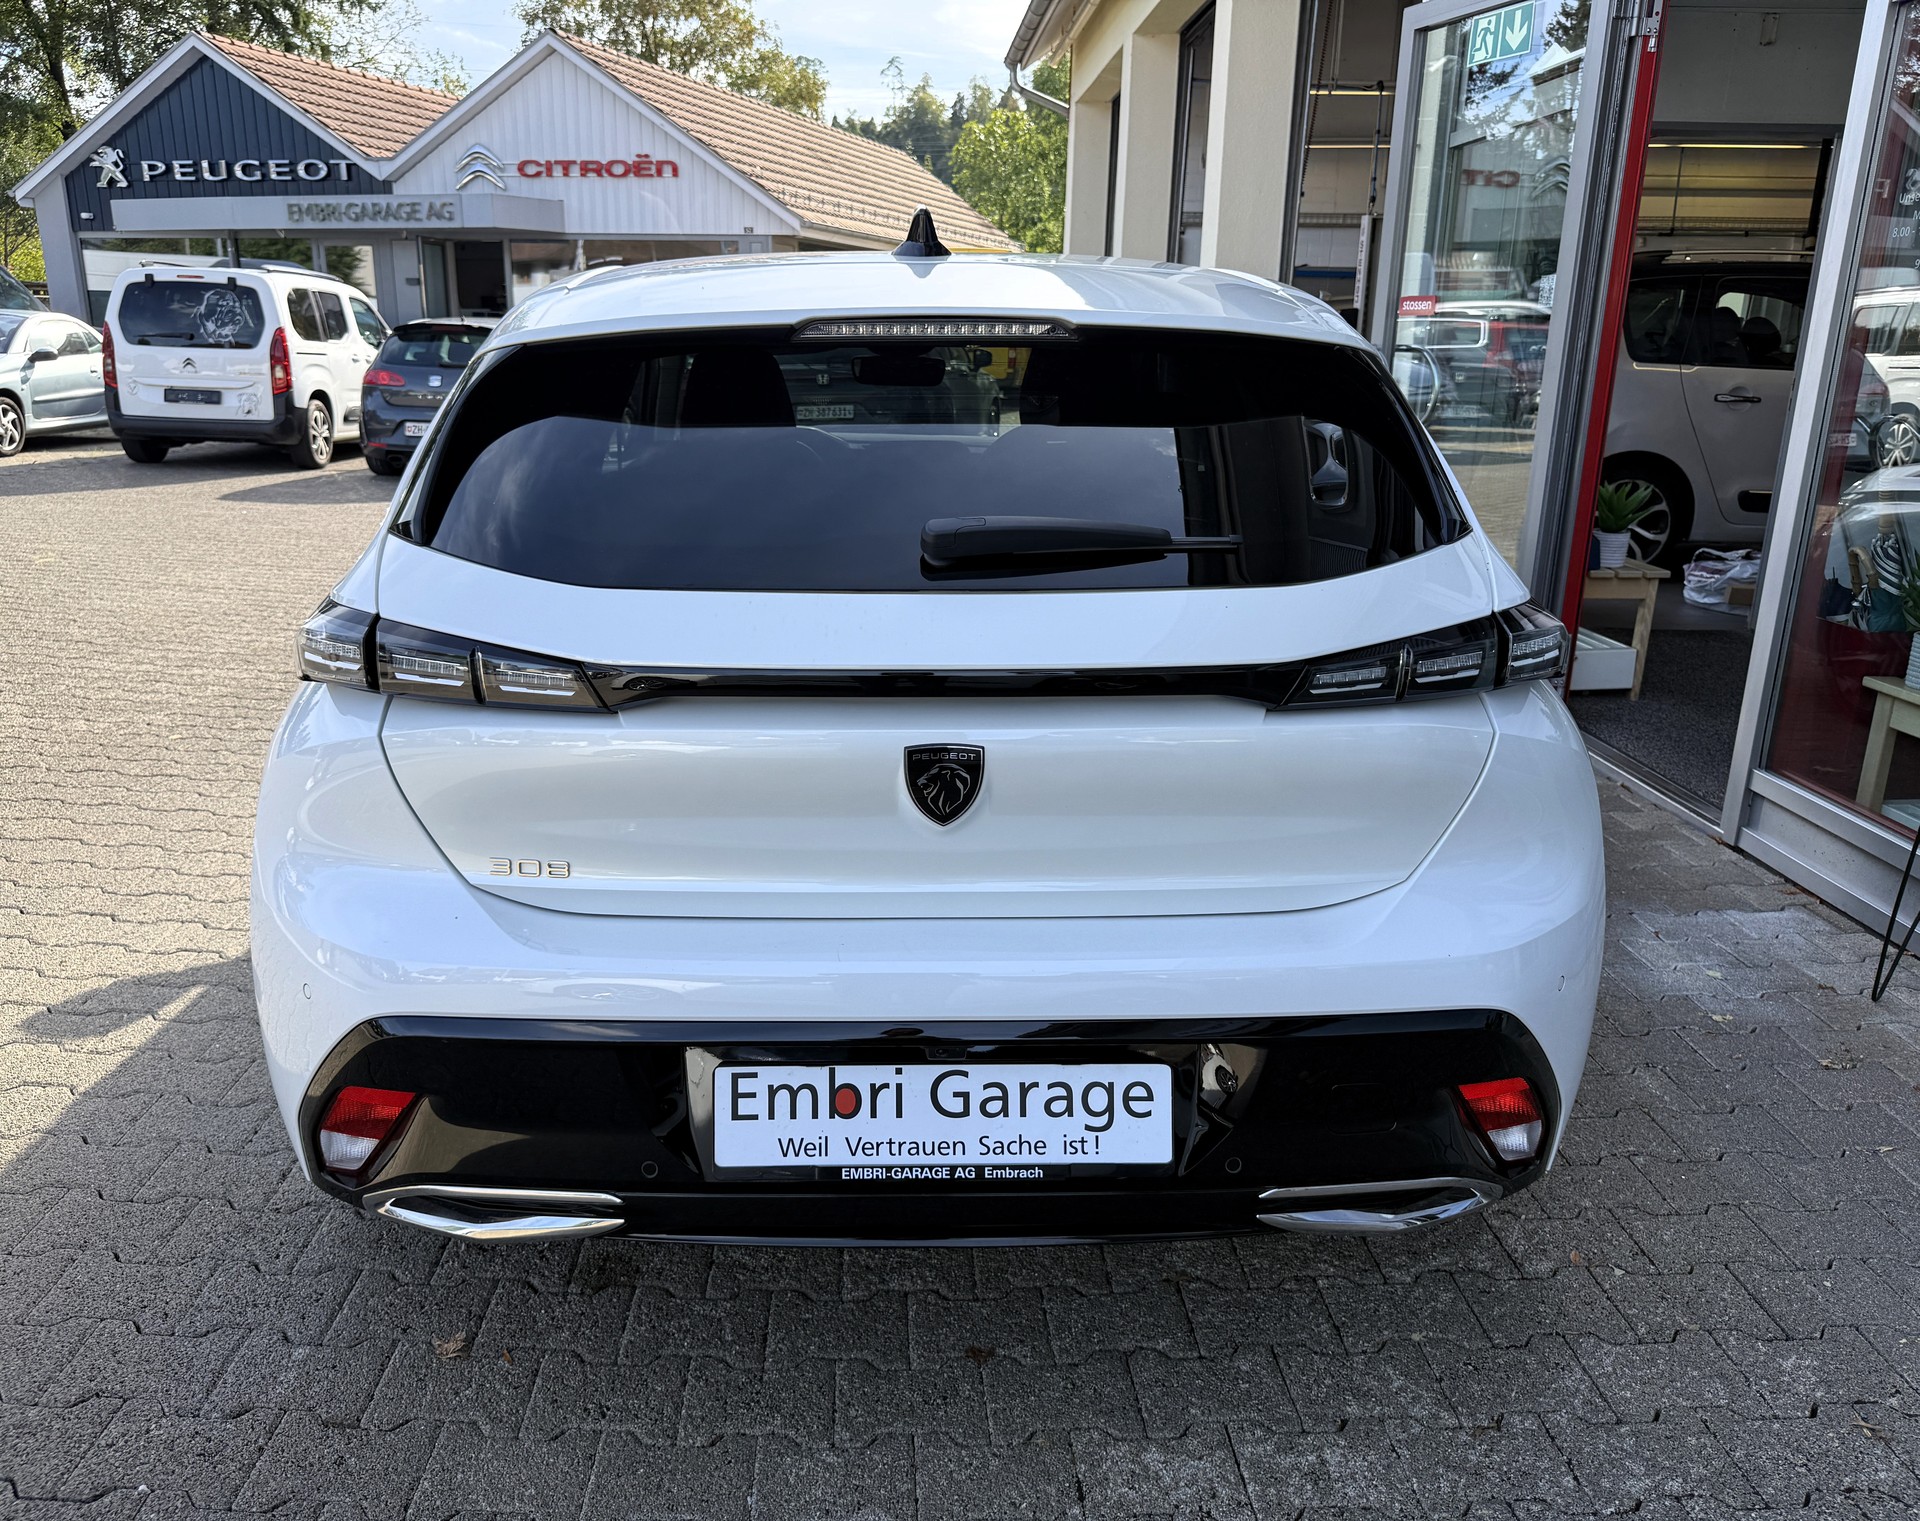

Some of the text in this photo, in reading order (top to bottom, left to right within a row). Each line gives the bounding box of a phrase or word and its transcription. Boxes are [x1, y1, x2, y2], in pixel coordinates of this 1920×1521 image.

[140, 159, 355, 182] PEUGEOT
[425, 201, 455, 221] AG
[1402, 300, 1432, 310] stossen
[912, 752, 976, 761] PEUGEOT
[489, 857, 570, 878] 308
[729, 1066, 1155, 1132] Embri Garage
[777, 1135, 1101, 1158] Weil Vertrauen Sache ist!
[842, 1167, 1043, 1180] EMBRI-GARAGE AG Embrach
